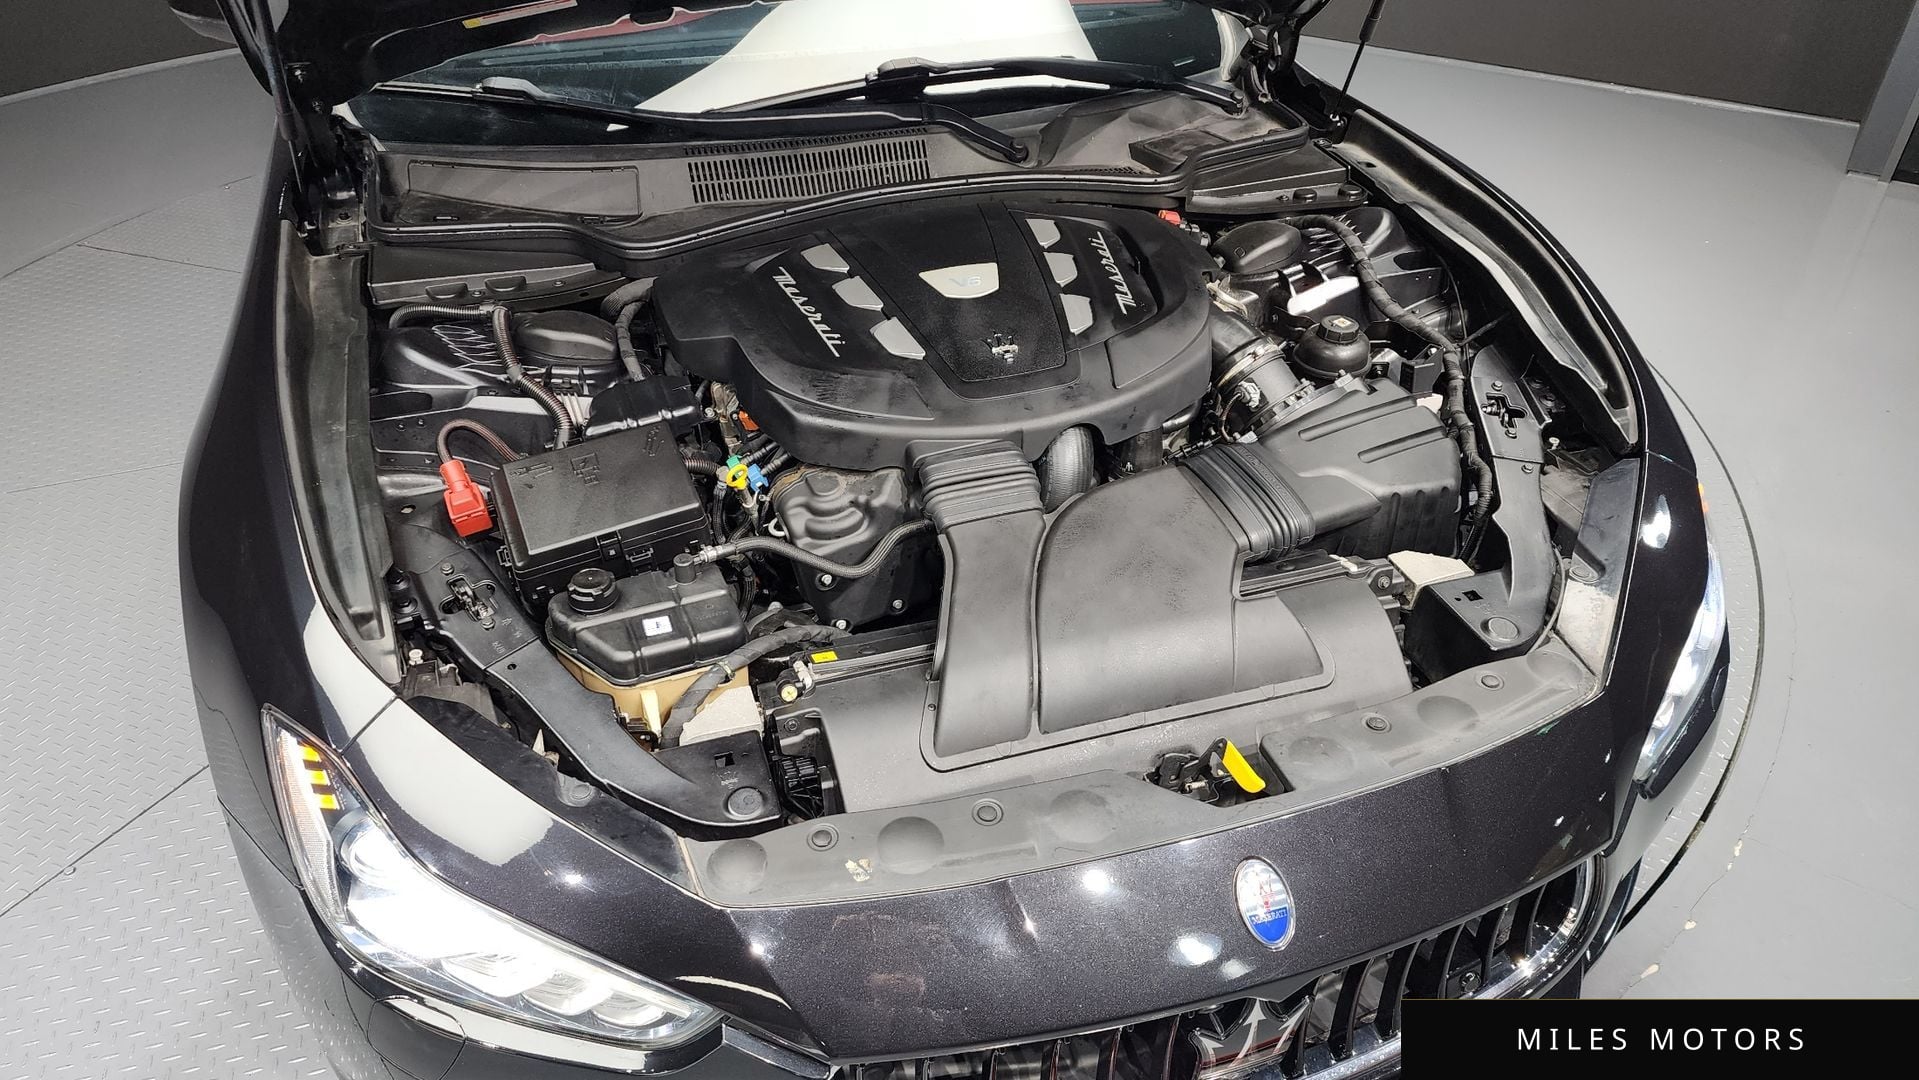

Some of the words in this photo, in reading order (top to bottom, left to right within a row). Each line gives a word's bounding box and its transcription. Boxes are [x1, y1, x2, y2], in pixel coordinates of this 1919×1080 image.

[772, 266, 846, 357] Maserati
[948, 274, 983, 288] V6
[1088, 231, 1136, 315] Maserati
